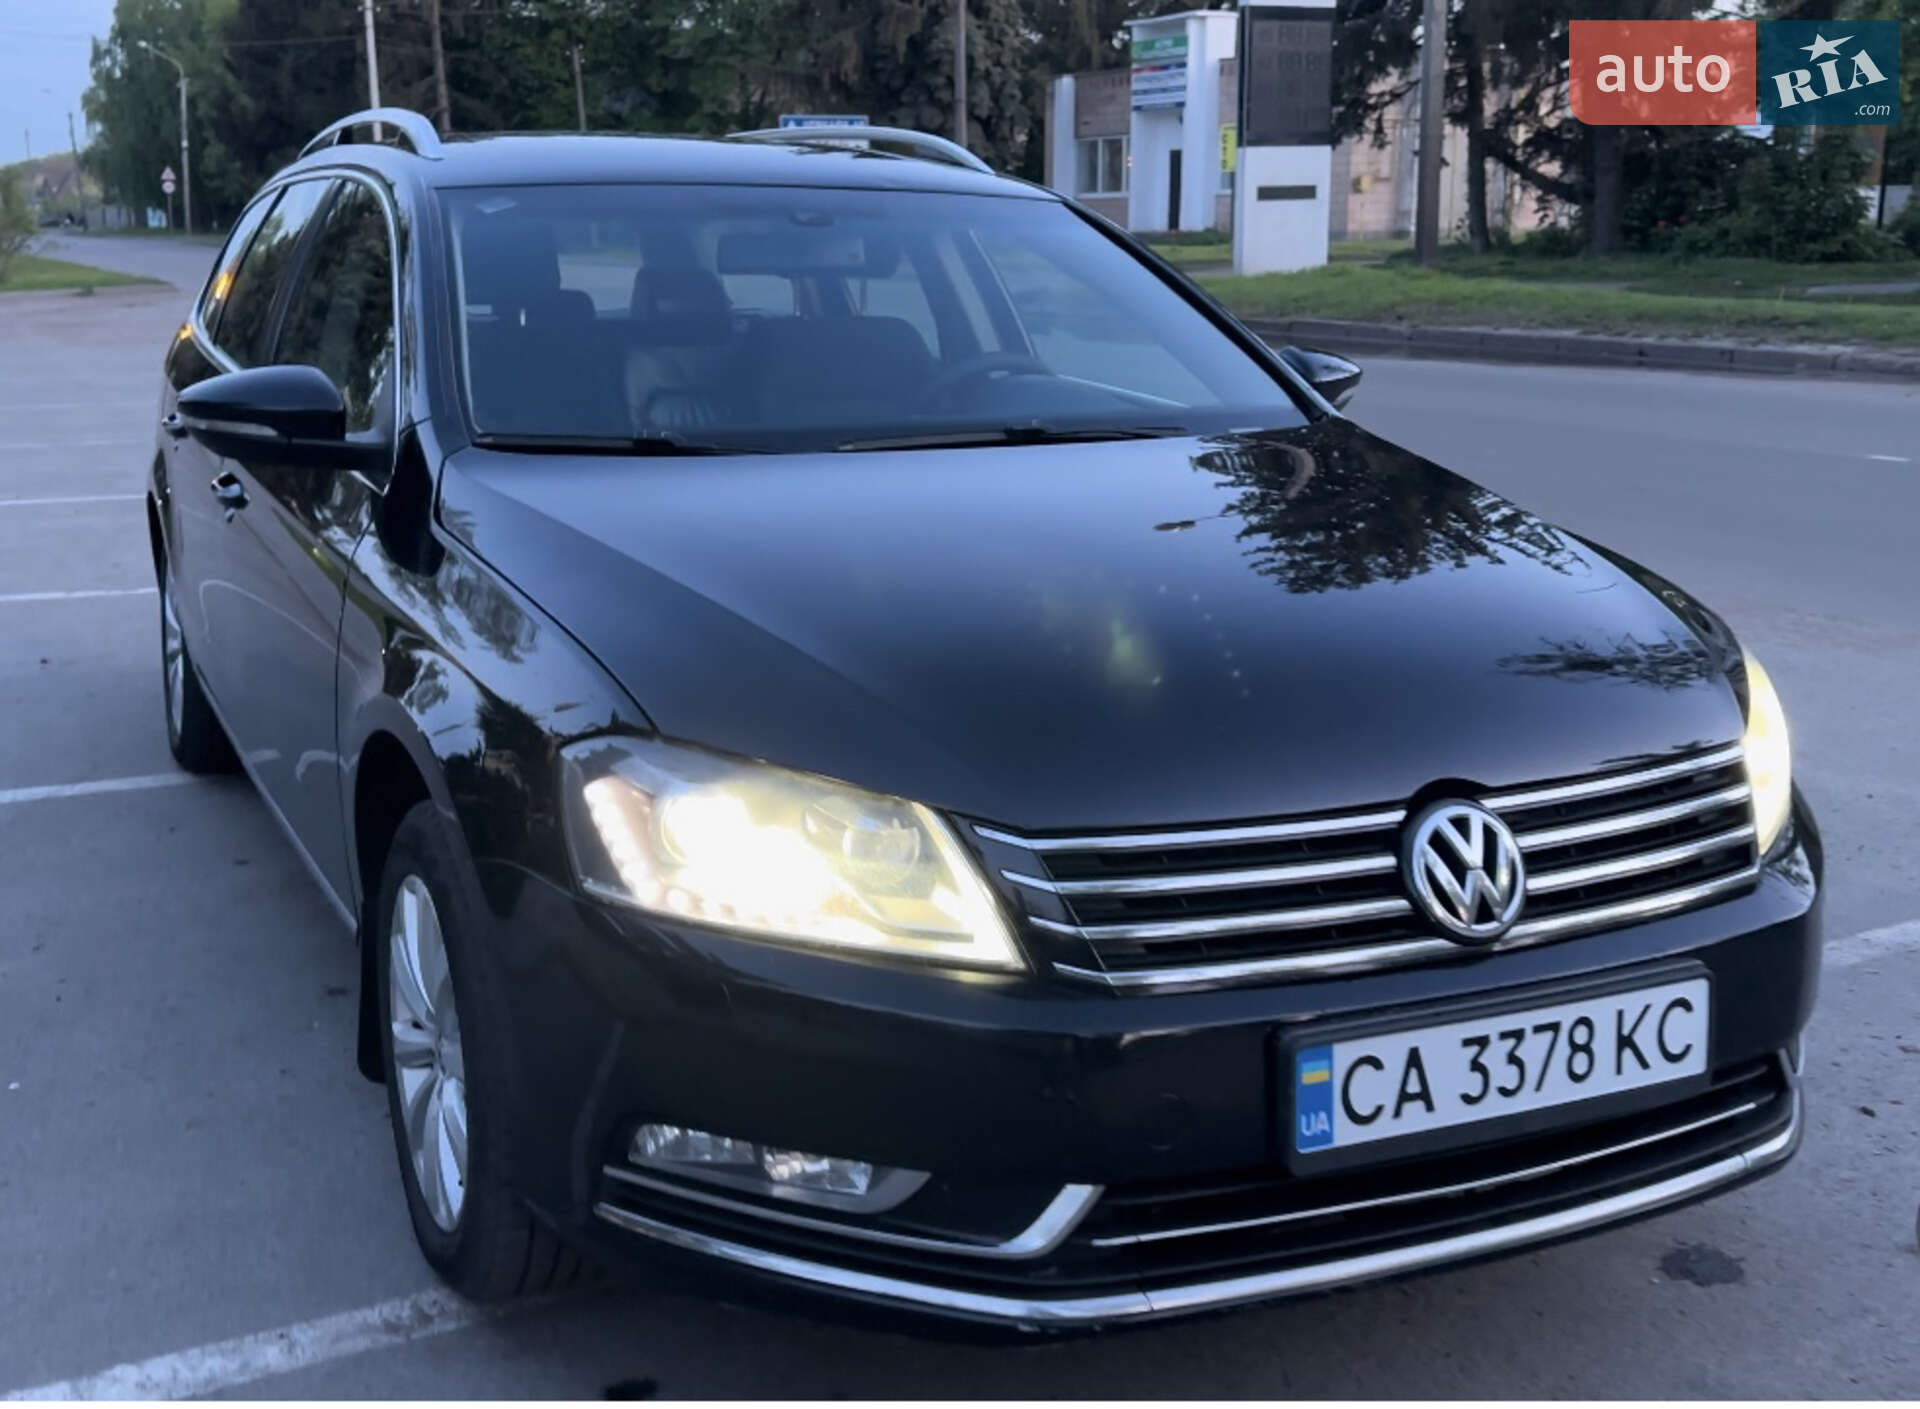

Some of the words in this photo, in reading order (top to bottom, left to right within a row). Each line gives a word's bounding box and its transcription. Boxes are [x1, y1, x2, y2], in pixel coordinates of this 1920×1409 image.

[1414, 807, 1523, 931] VW
[1301, 1110, 1330, 1136] UA
[1341, 1046, 1435, 1126] CA
[1459, 1016, 1595, 1105] 3378
[1615, 997, 1694, 1076] KC
